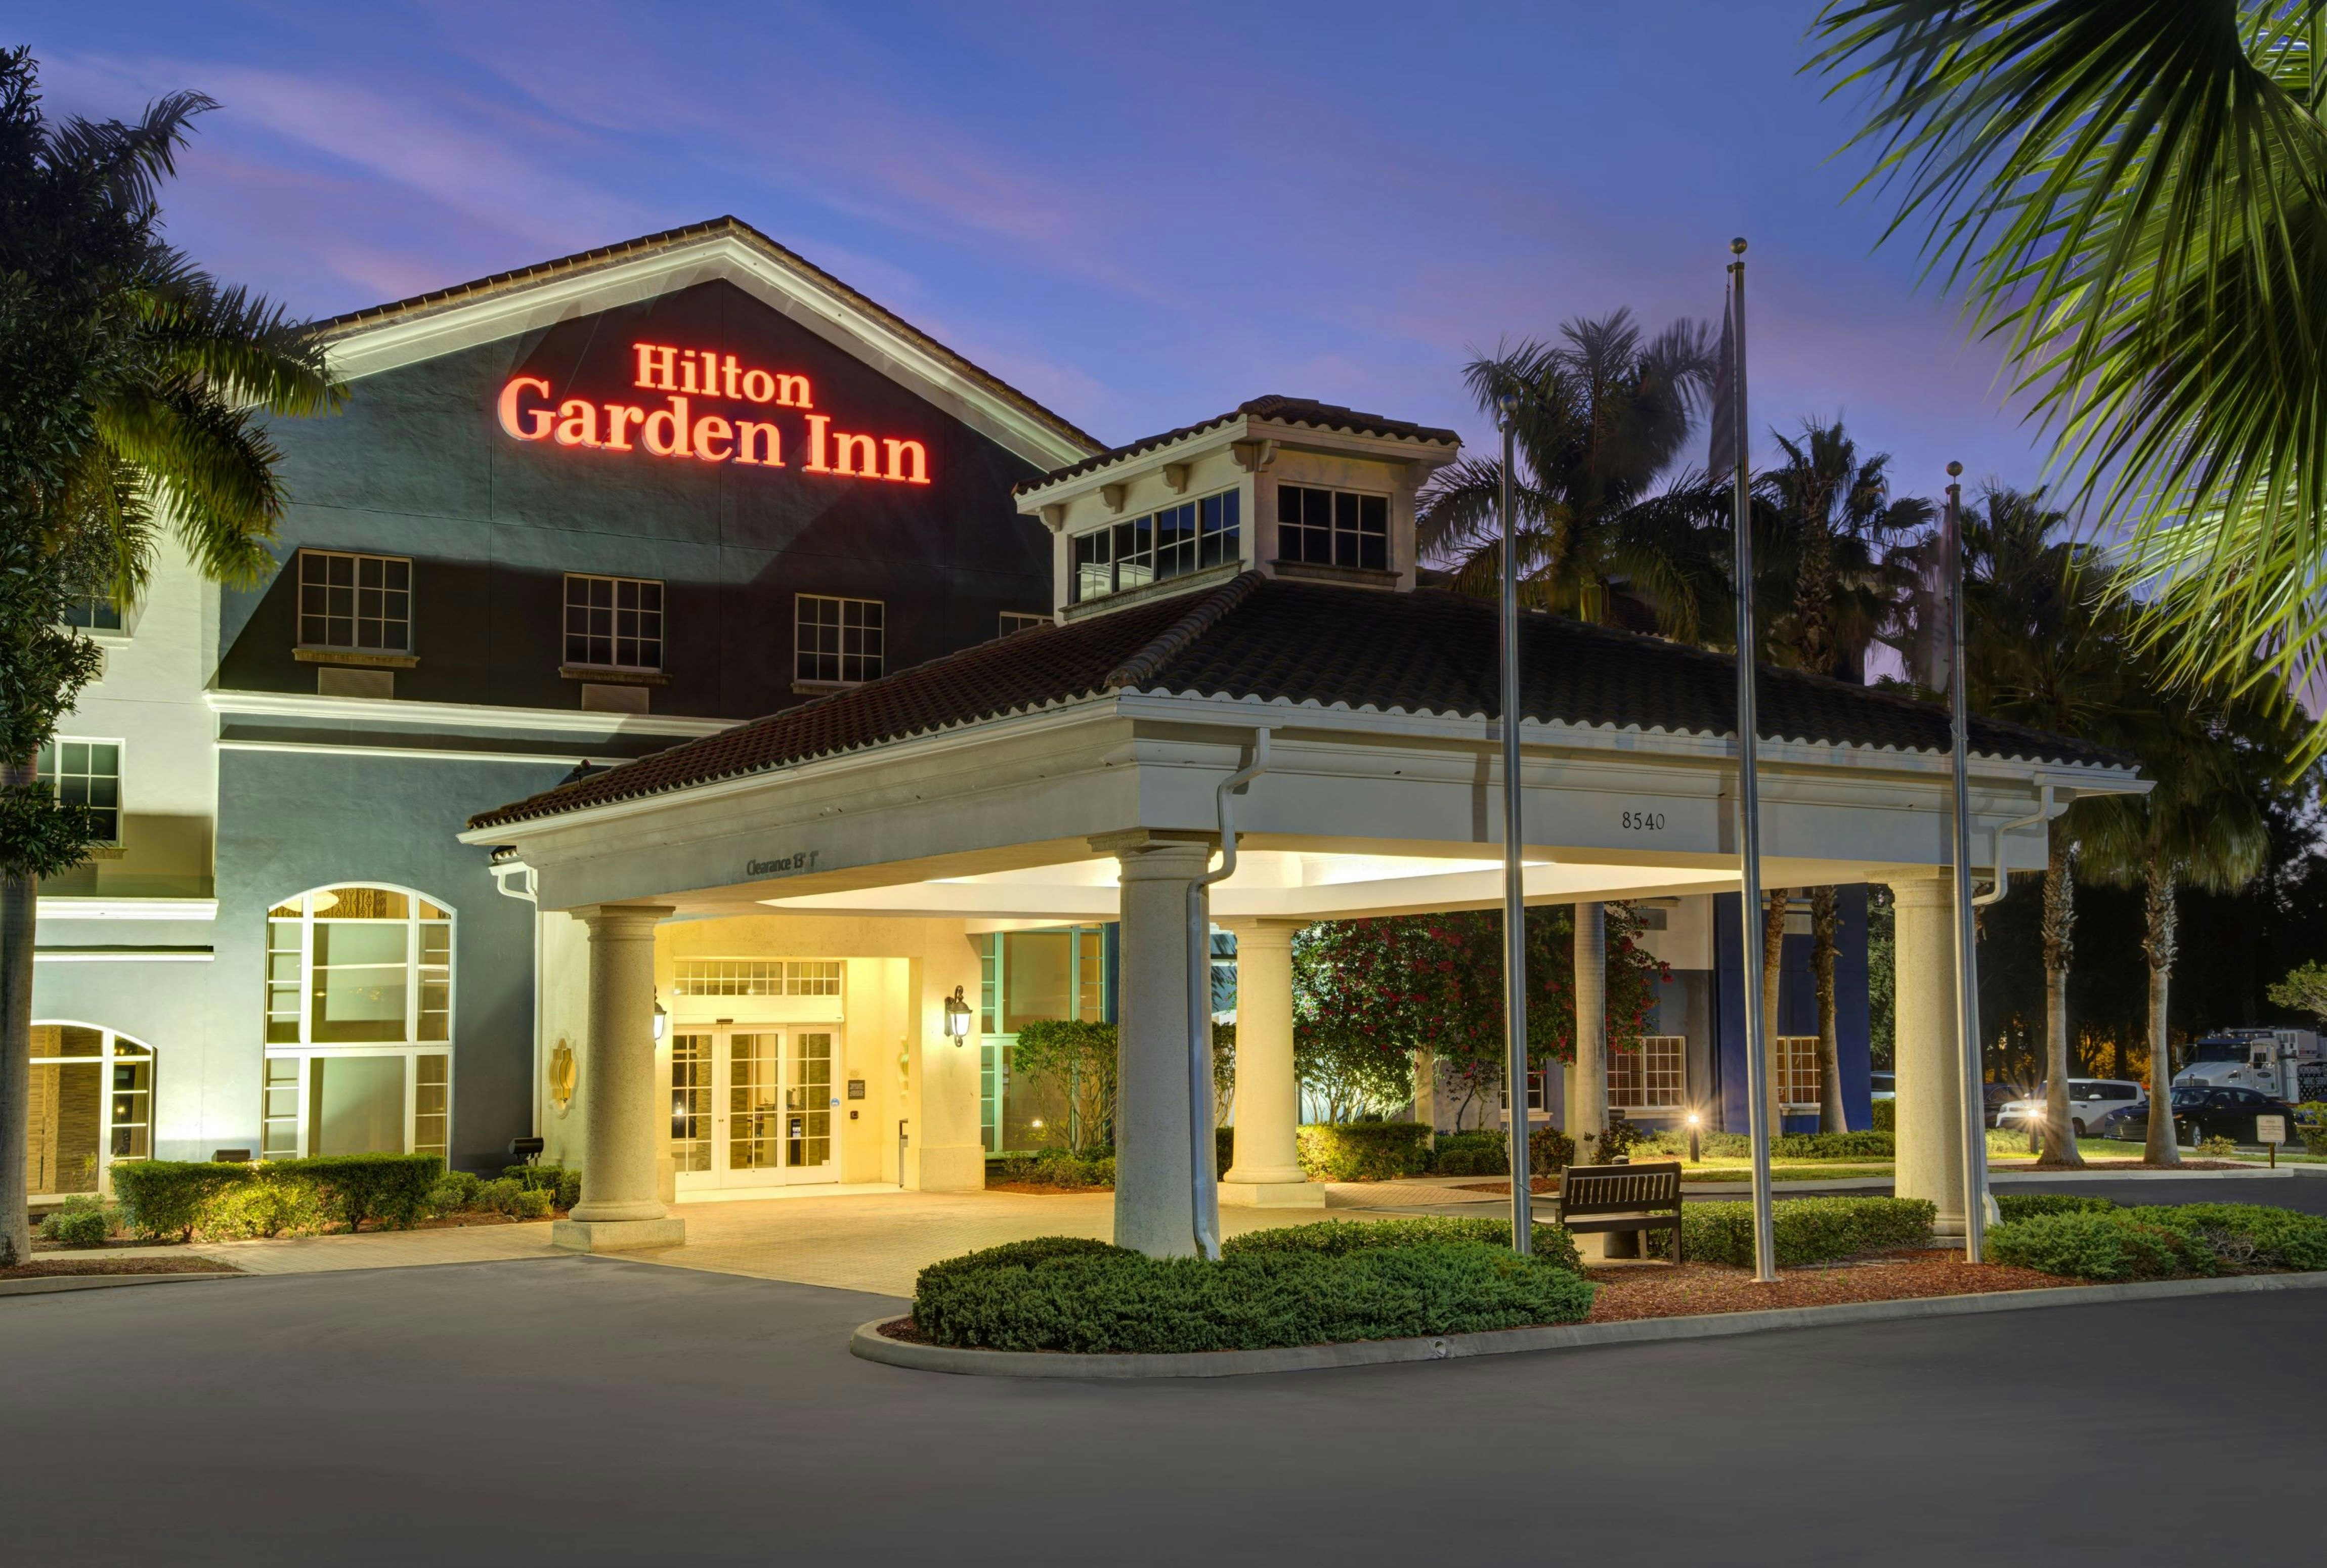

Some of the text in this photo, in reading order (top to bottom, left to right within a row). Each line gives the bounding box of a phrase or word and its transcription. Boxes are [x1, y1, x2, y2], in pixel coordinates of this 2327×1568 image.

[633, 342, 813, 409] Hilton
[497, 377, 931, 484] Garden Inn
[1622, 811, 1665, 830] 8540
[747, 858, 791, 876] Clearance
